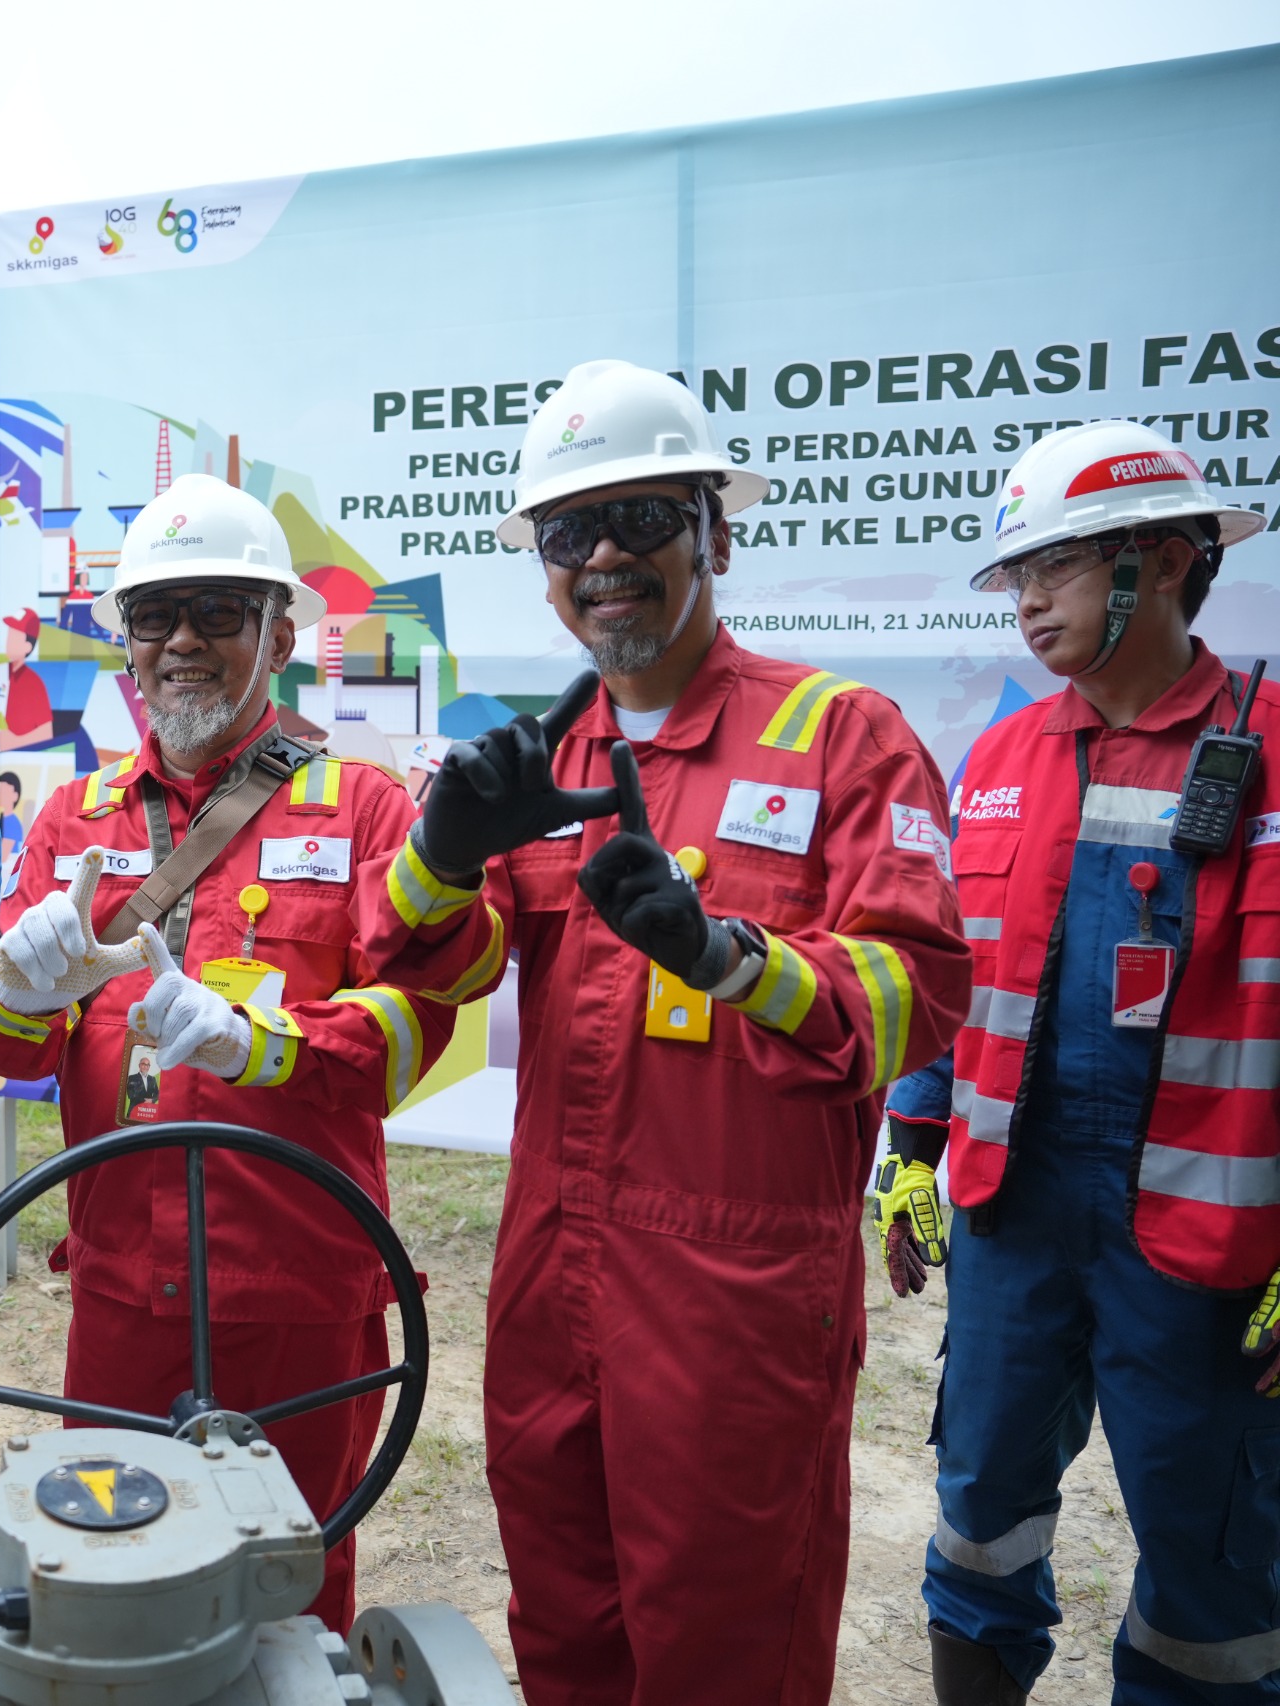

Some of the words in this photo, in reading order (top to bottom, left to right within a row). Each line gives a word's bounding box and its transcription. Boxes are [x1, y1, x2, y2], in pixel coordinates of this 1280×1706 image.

[7, 256, 78, 271] skkmigas
[774, 342, 1108, 409] OPERASI
[547, 434, 606, 459] skkmigas
[767, 426, 976, 463] PERDANA
[1109, 455, 1187, 482] PERTAMINA
[762, 475, 848, 505] DAN
[821, 516, 878, 546] KE
[895, 513, 982, 545] LPG
[150, 535, 203, 550] skkmigas
[720, 614, 876, 633] PRABUMULIH,
[883, 613, 908, 630] 21
[916, 612, 1021, 630] JANUAR
[969, 787, 1023, 807] HSSE
[960, 806, 1021, 820] MARSHAL
[726, 821, 801, 845] skkmigas
[272, 863, 338, 876] skkmigas
[204, 980, 230, 988] VISITOR
